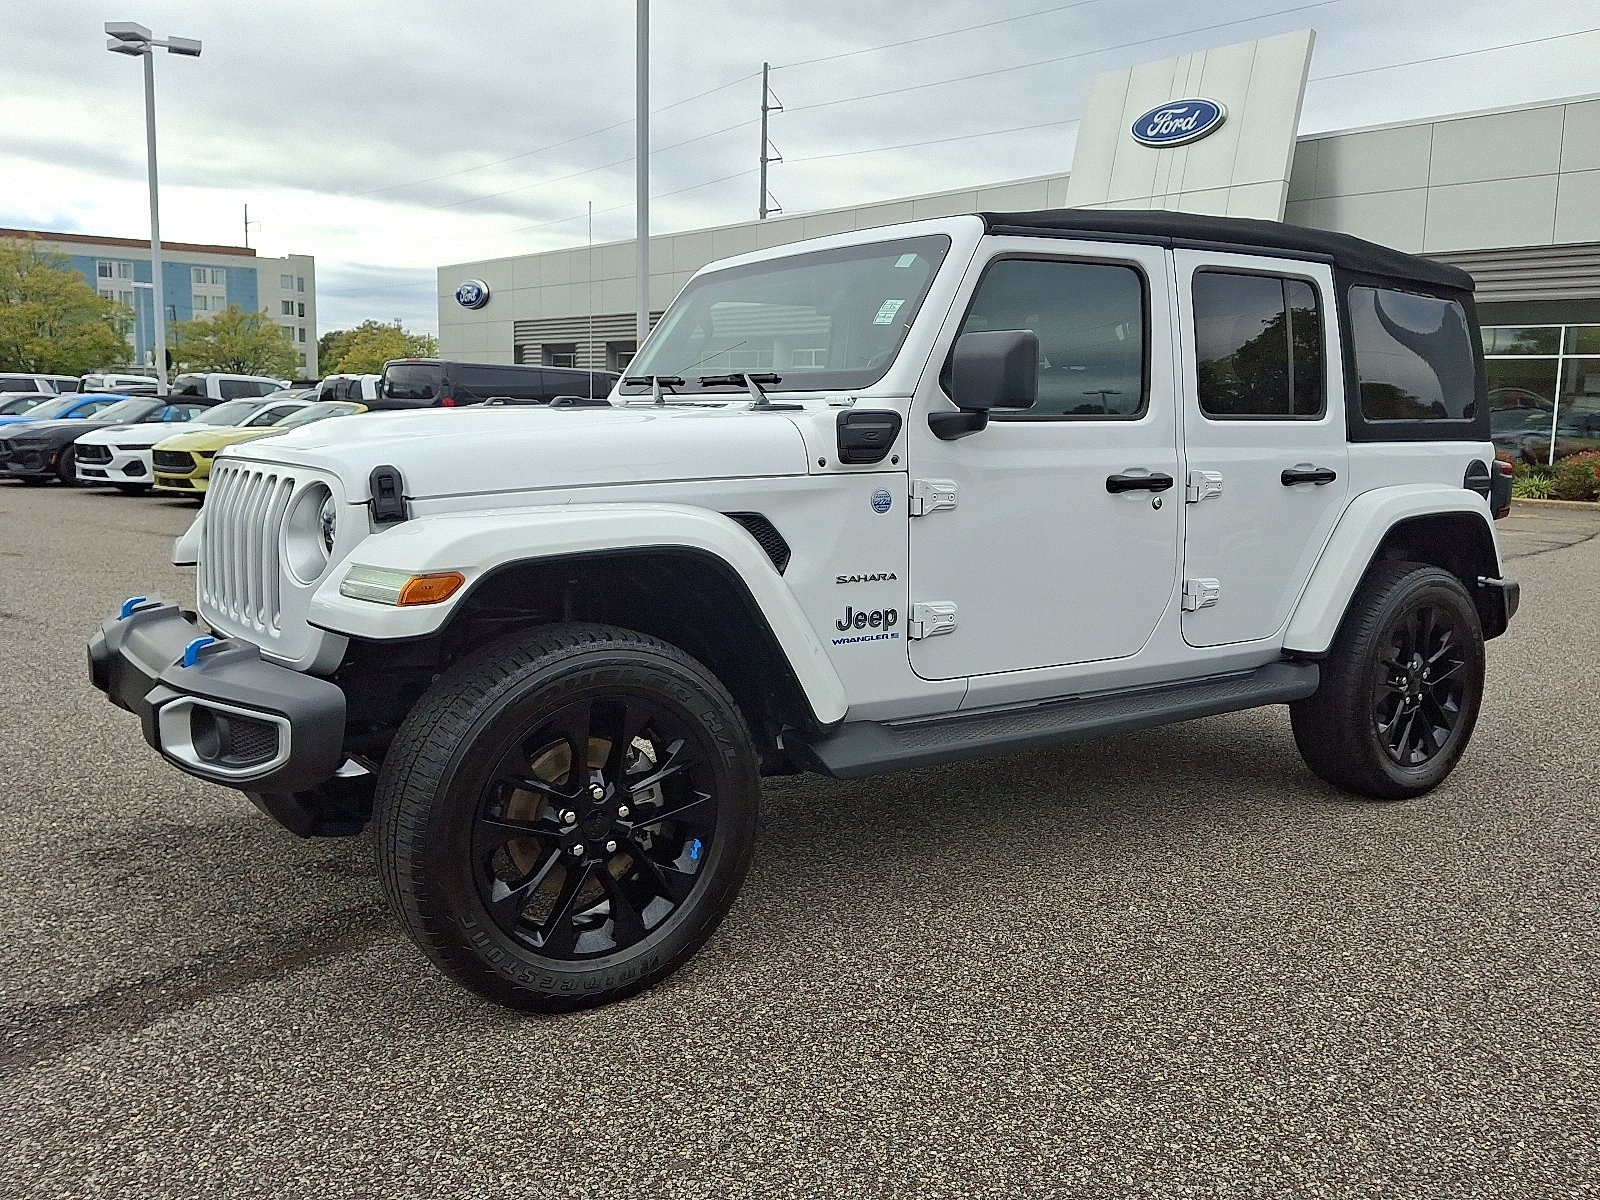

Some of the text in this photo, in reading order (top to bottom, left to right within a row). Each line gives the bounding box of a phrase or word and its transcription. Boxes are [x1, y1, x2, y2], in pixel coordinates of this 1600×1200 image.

[1146, 107, 1201, 137] Ford
[460, 286, 478, 302] Ford
[836, 572, 897, 584] SAHARA
[836, 605, 898, 632] Jeep
[832, 633, 889, 646] WRANGLER
